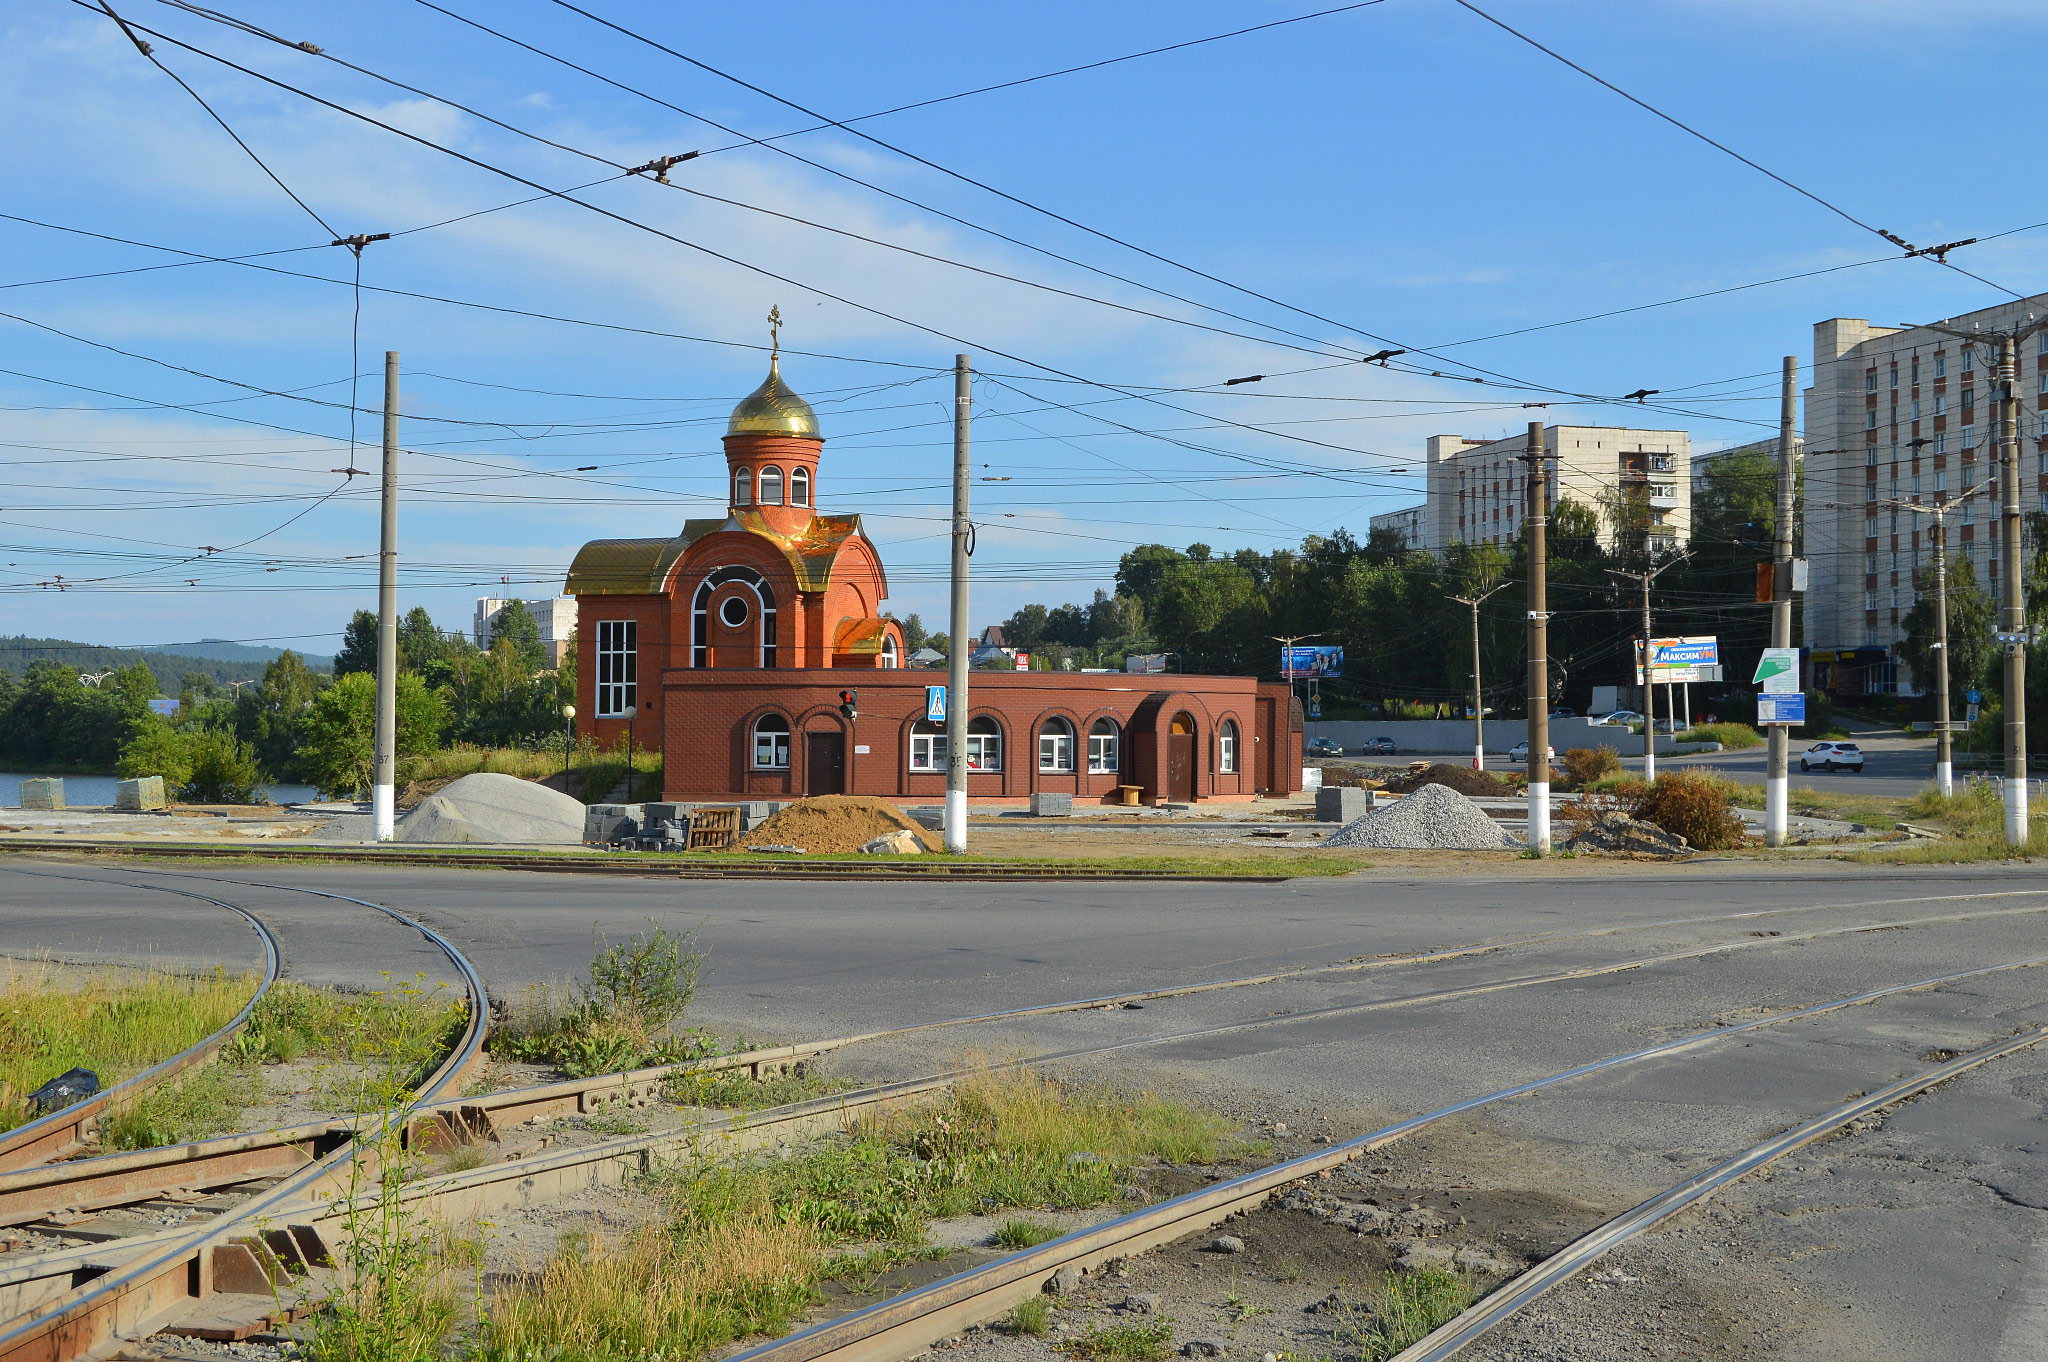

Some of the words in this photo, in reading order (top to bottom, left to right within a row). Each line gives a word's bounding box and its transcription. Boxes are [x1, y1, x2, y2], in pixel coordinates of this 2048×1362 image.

[378, 755, 389, 764] 37
[950, 756, 961, 767] 35
[1535, 754, 1545, 764] 33
